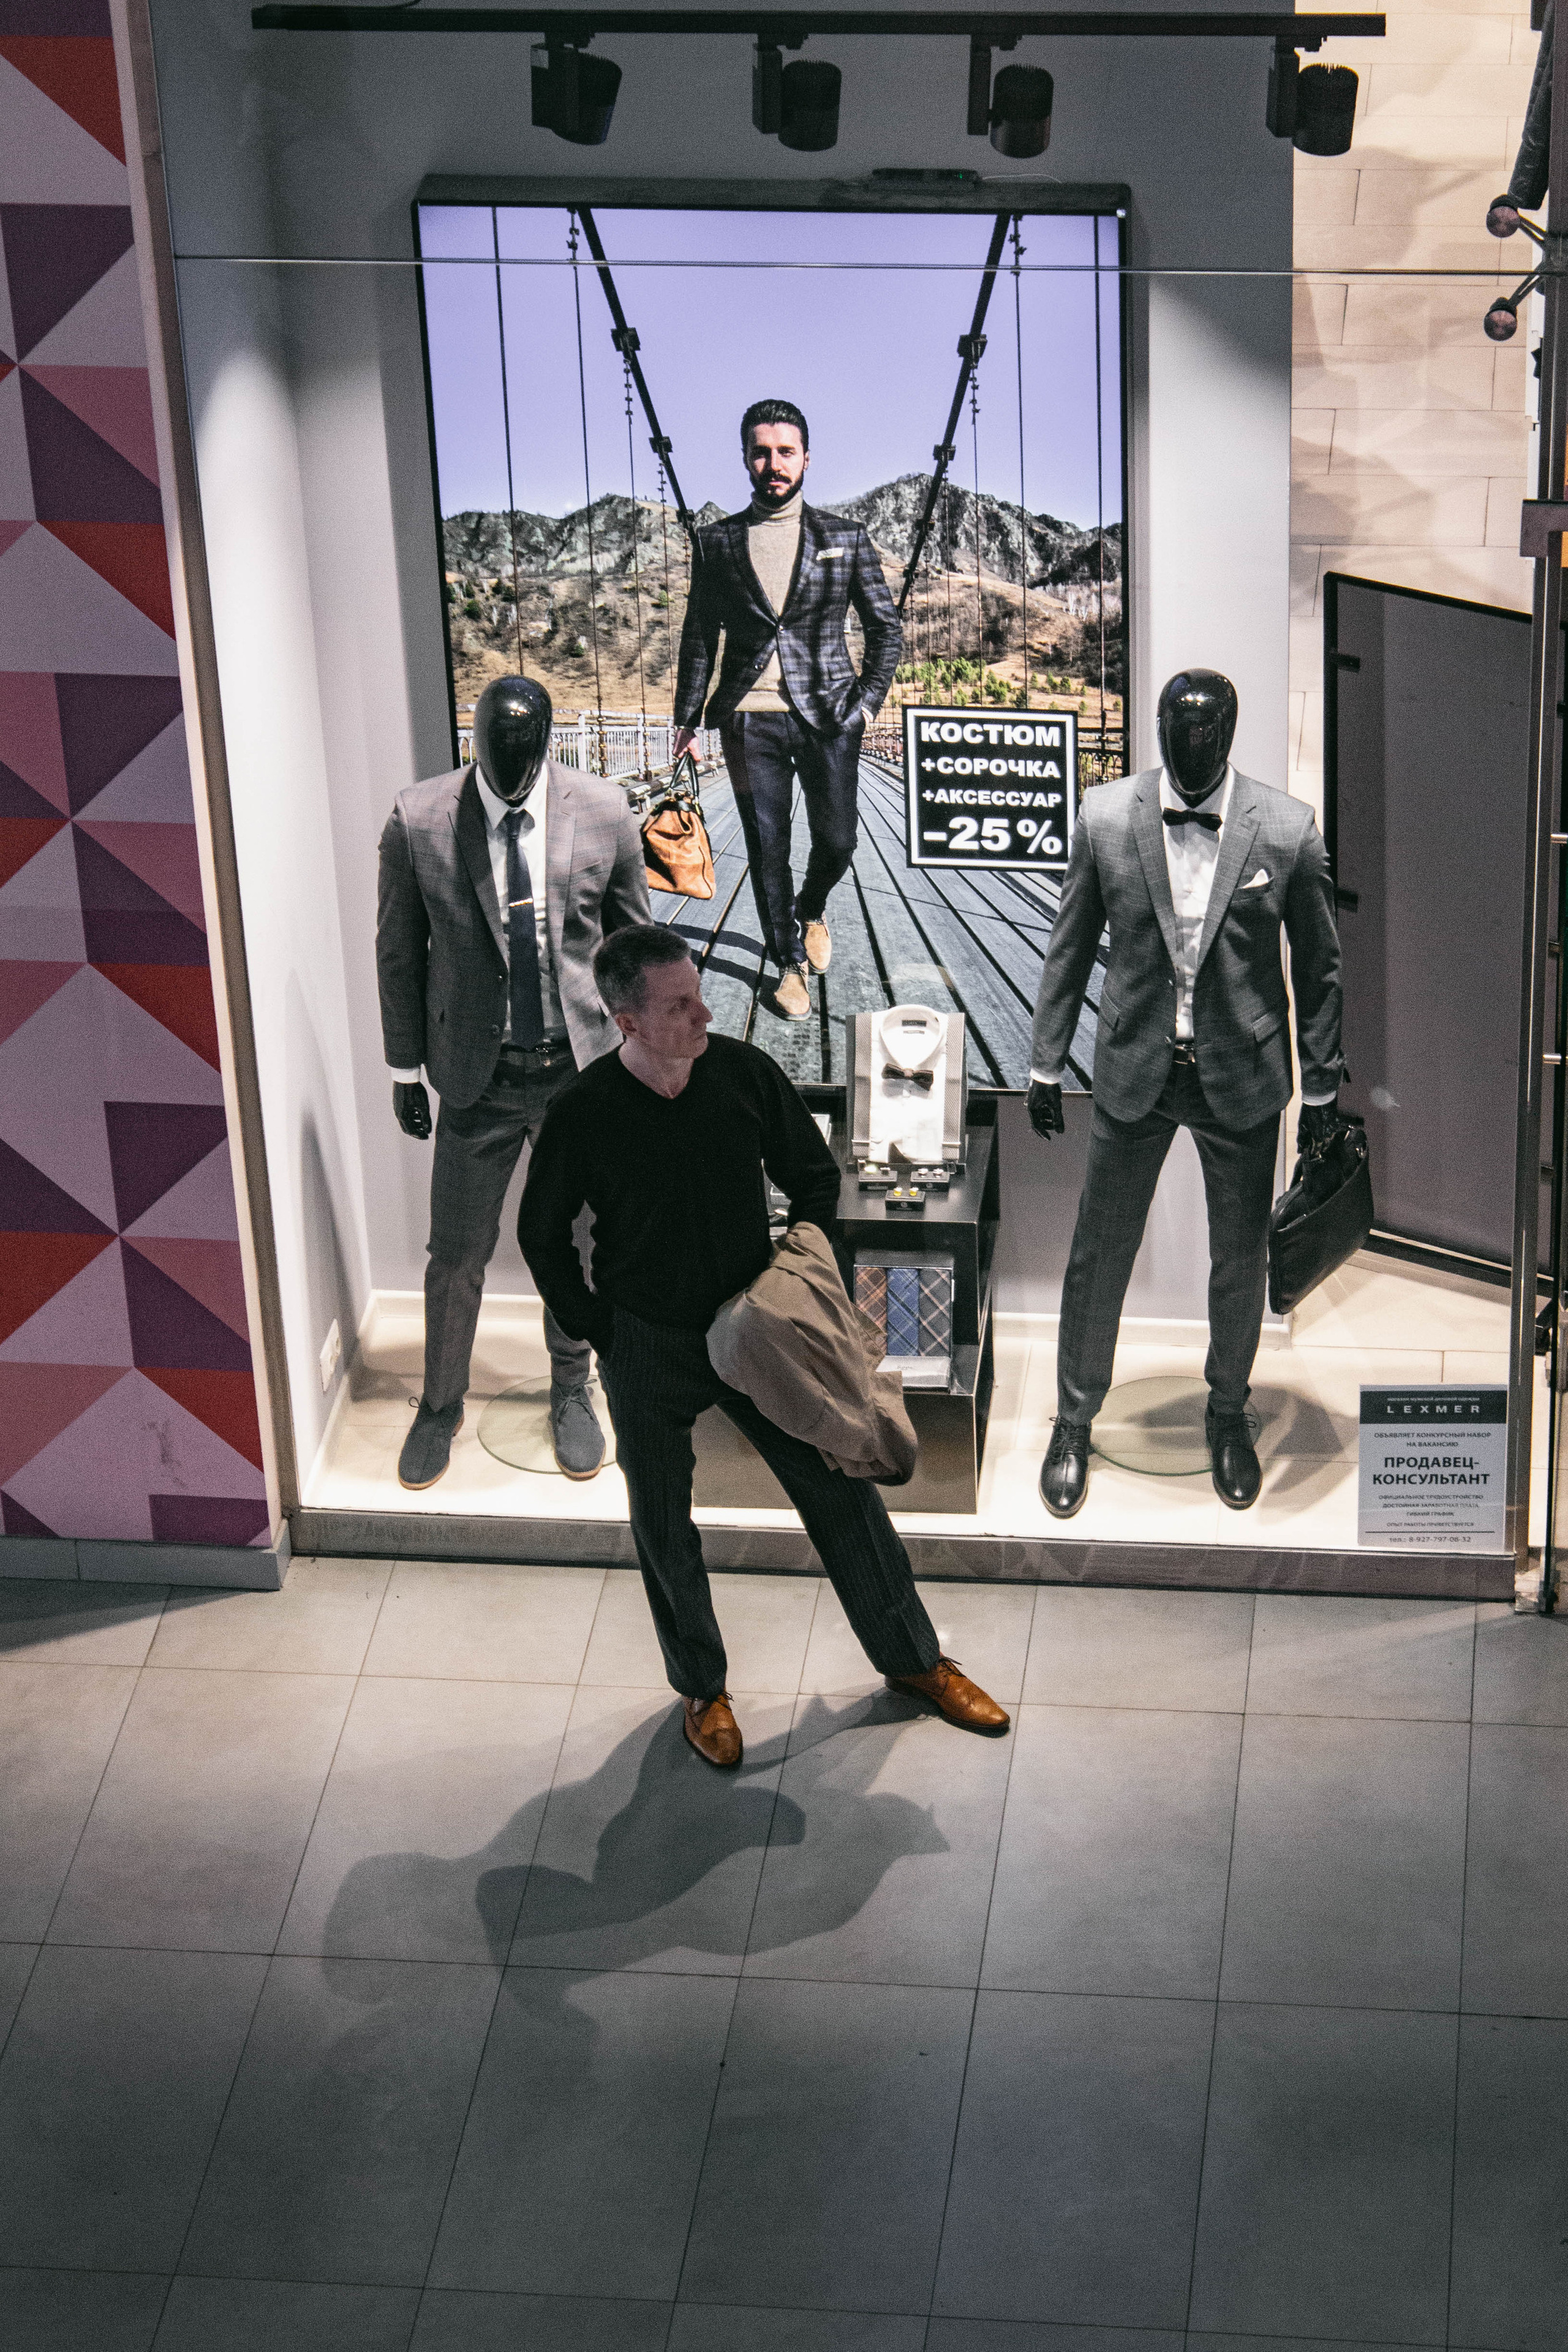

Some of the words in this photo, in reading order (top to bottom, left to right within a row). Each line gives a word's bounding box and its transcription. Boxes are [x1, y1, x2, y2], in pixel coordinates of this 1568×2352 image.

[921, 721, 1061, 747] КОСТЮМ
[921, 756, 1061, 778] +СОРОЧКА
[922, 788, 1062, 808] +АКСЕССУАР
[1387, 1405, 1480, 1414] LEXMER
[1384, 1457, 1479, 1470] ПРОДАВЕЦ-
[1373, 1474, 1490, 1485] КОНСУЛЬТАНТ
